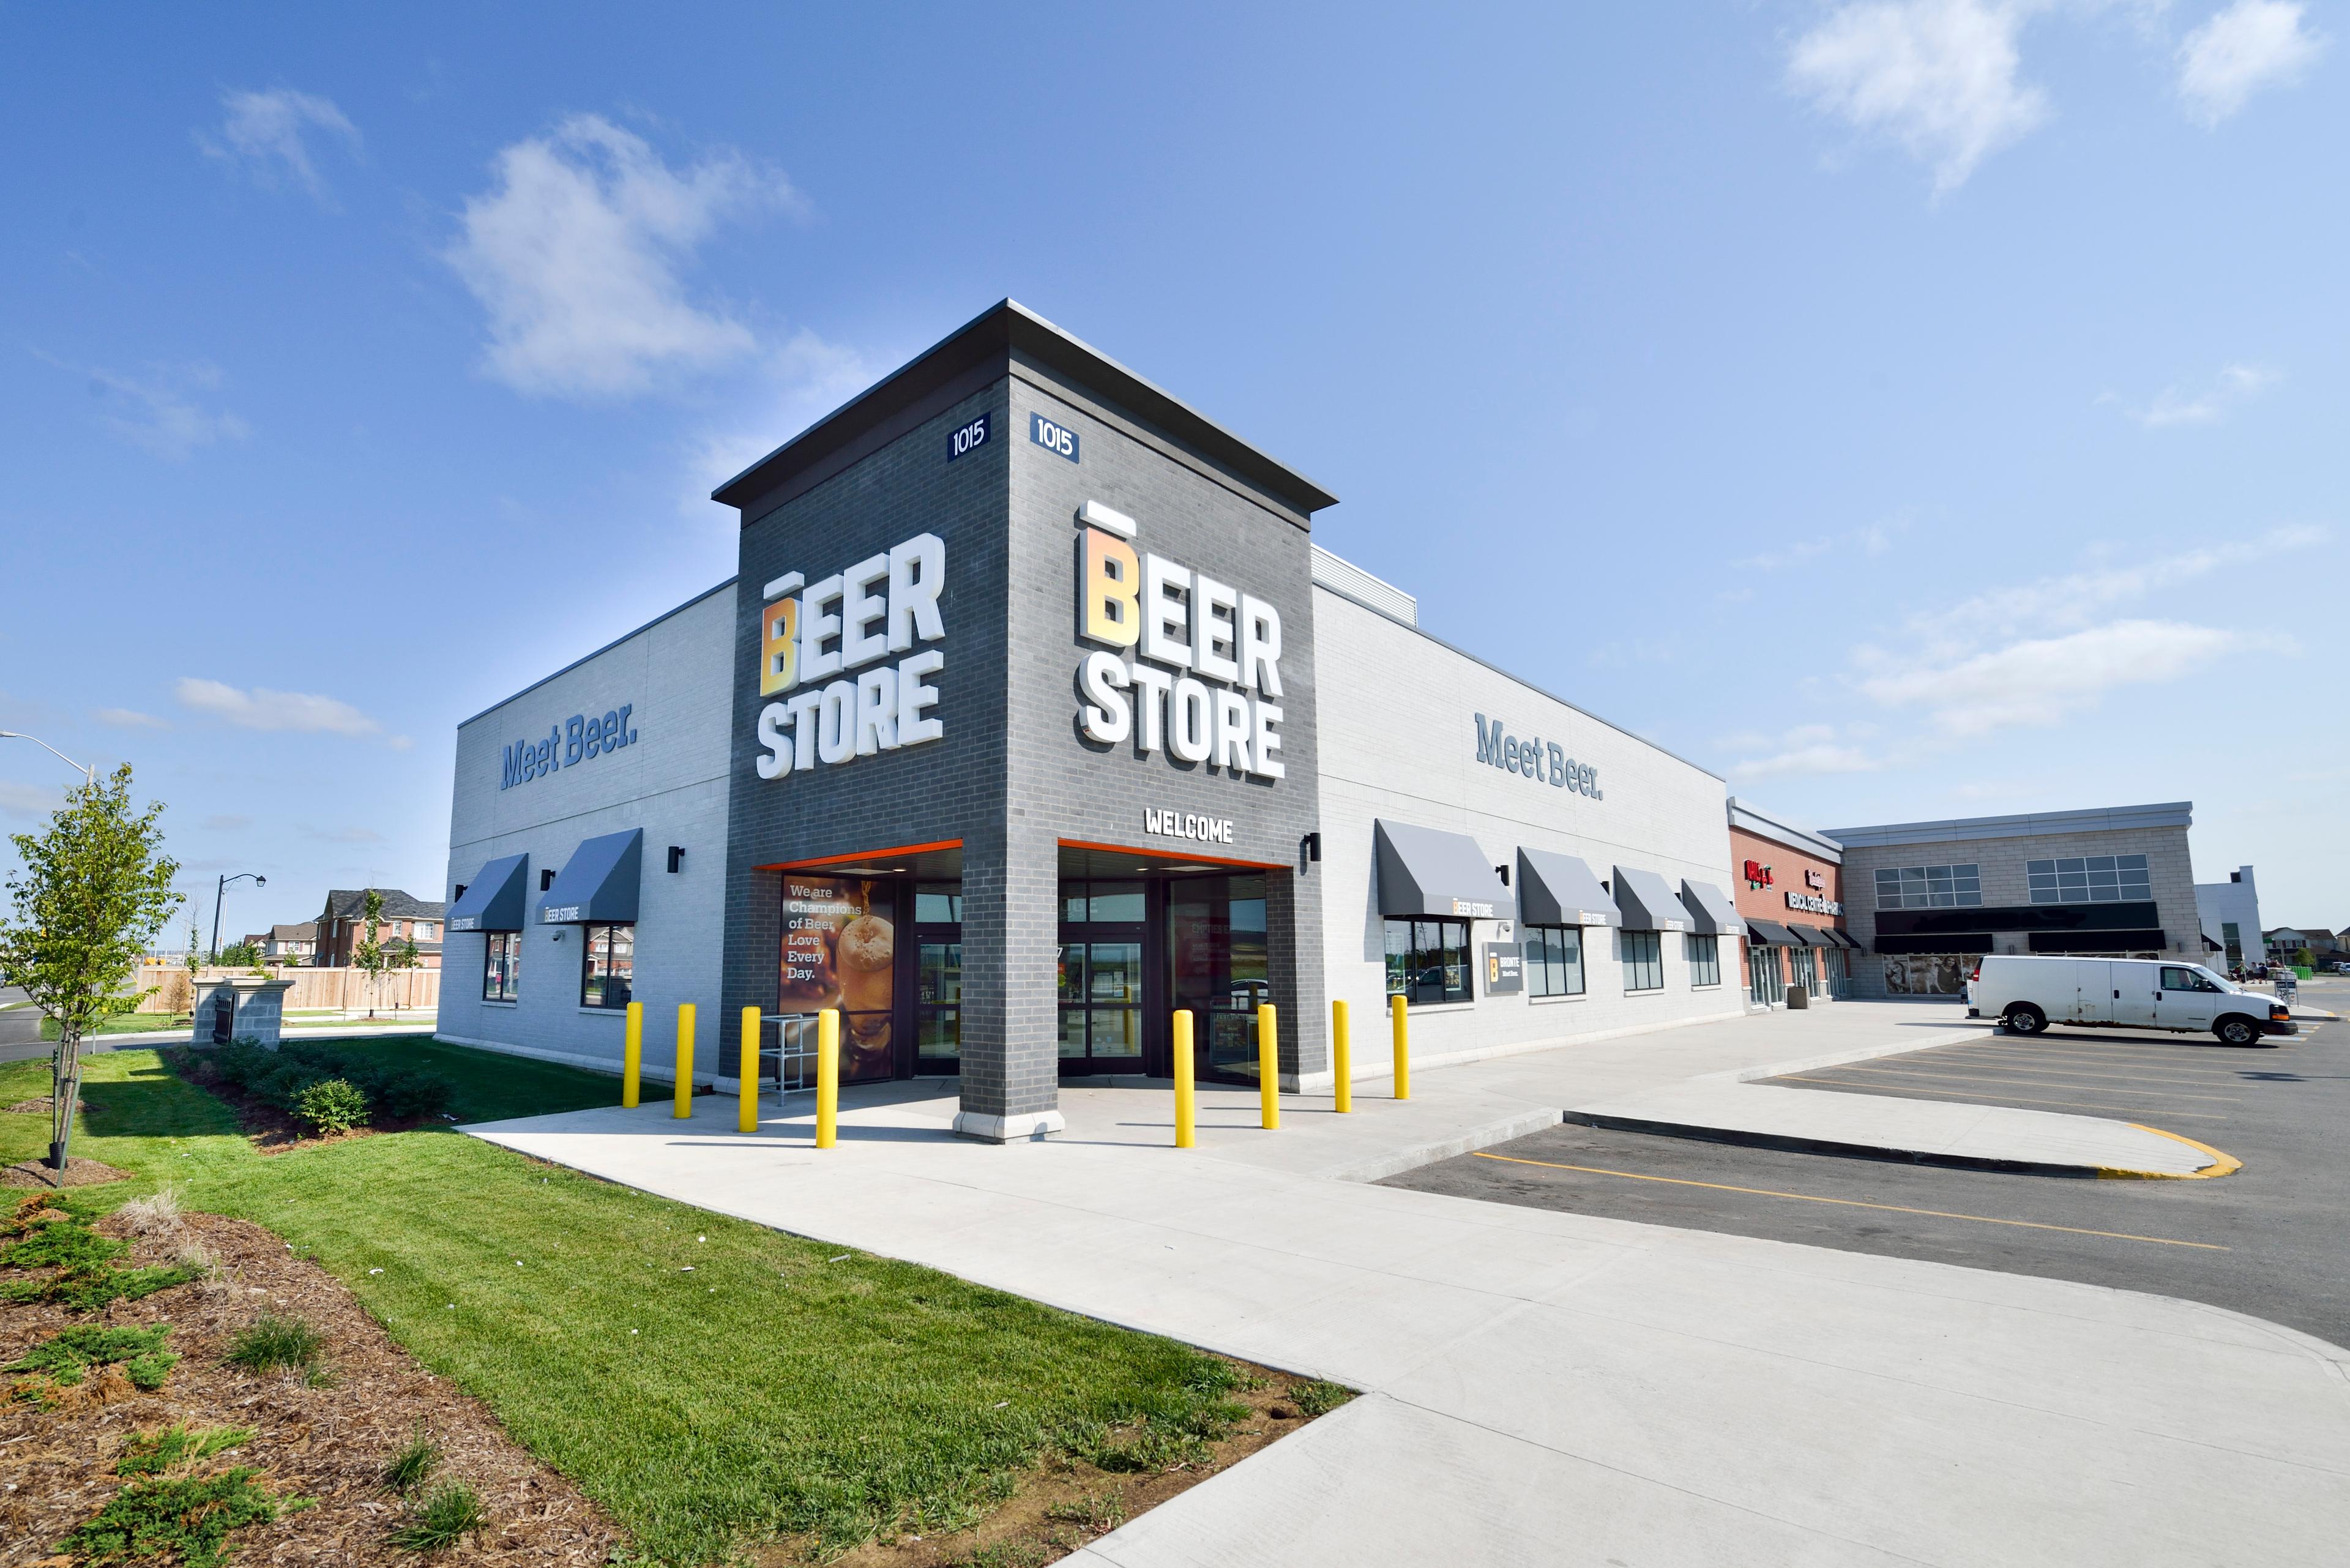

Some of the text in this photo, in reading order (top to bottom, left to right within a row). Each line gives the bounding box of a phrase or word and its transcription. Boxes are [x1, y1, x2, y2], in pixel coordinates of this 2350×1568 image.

[953, 419, 985, 456] 1015
[1038, 419, 1073, 455] 1015
[1079, 499, 1283, 697] BEER
[759, 532, 946, 697] BEER
[756, 649, 944, 780] STORE
[1079, 651, 1285, 779] STORE
[501, 703, 637, 791] Meet Beer.
[1475, 712, 1603, 801] Meet Beer.
[1146, 807, 1233, 843] WELCOME
[790, 885, 832, 898] We are
[1788, 891, 1808, 910] MEDICAL
[545, 906, 579, 922] BEER STORE
[789, 901, 862, 916] Champions
[1453, 897, 1493, 917] BEER STORE
[1580, 909, 1606, 924] BEER STORE
[461, 918, 474, 930] STORE
[789, 917, 803, 929] of
[788, 934, 820, 946] Love
[788, 950, 824, 965] Every
[1500, 957, 1520, 968] BRONTE
[787, 967, 815, 981] Day.
